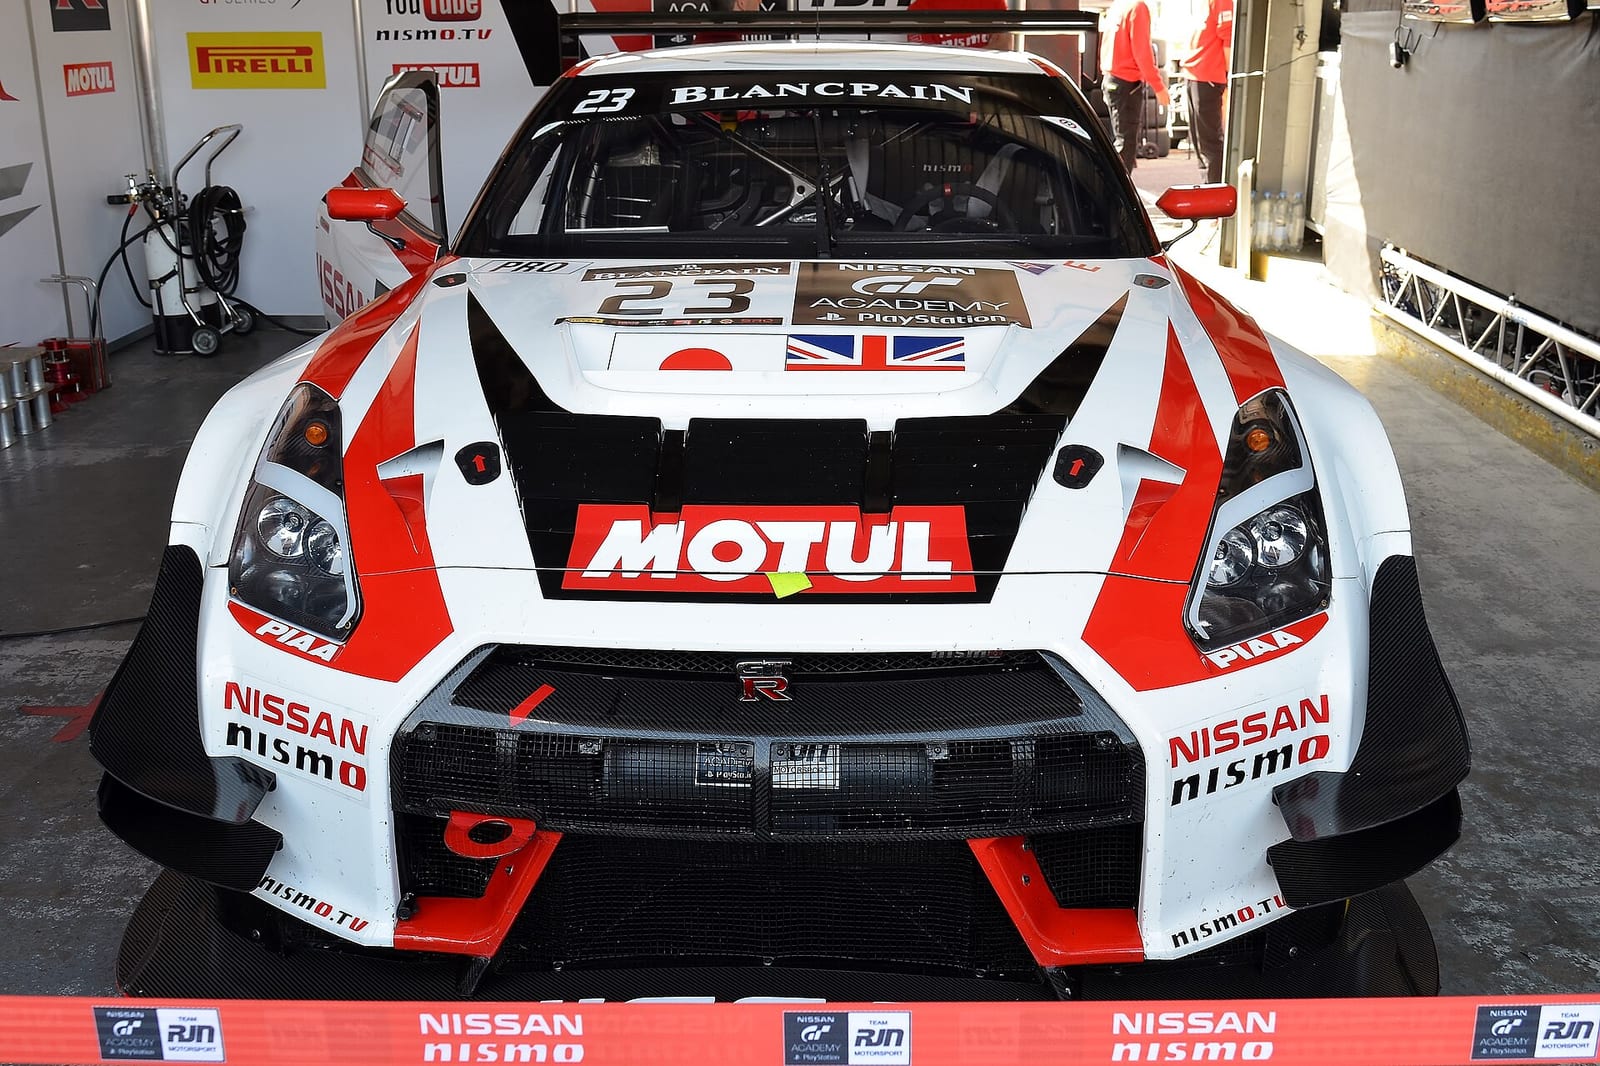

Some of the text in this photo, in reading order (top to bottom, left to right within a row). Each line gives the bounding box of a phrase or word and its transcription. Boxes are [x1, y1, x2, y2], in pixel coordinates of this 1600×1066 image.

[196, 46, 313, 73] PIRELLI
[67, 66, 112, 92] MOTUL
[400, 66, 477, 84] TUL
[573, 88, 635, 114] 23
[670, 83, 973, 104] BLANCPAIN
[490, 261, 569, 273] PRO
[593, 267, 782, 279] BLANCPAIN
[839, 263, 976, 275] NISSAN
[597, 278, 756, 316] 23
[809, 297, 1009, 312] ACADEMY
[858, 313, 1007, 324] PlayStation
[581, 519, 953, 582] MOTUL
[255, 619, 339, 662] PIAA
[1206, 630, 1304, 669] PIAA
[224, 681, 368, 755] NISSAN
[1169, 694, 1329, 768] NISSAN
[226, 722, 367, 791] nismo
[1171, 734, 1330, 806] nismo
[419, 1013, 583, 1035] NISSAN
[1112, 1011, 1276, 1034] NISSAN
[1489, 1009, 1528, 1017] NISSAN
[424, 1043, 584, 1062] nismo
[791, 1043, 840, 1052] ACADEMY
[1111, 1042, 1273, 1062] nismo
[1480, 1038, 1529, 1047] ACADEMY
